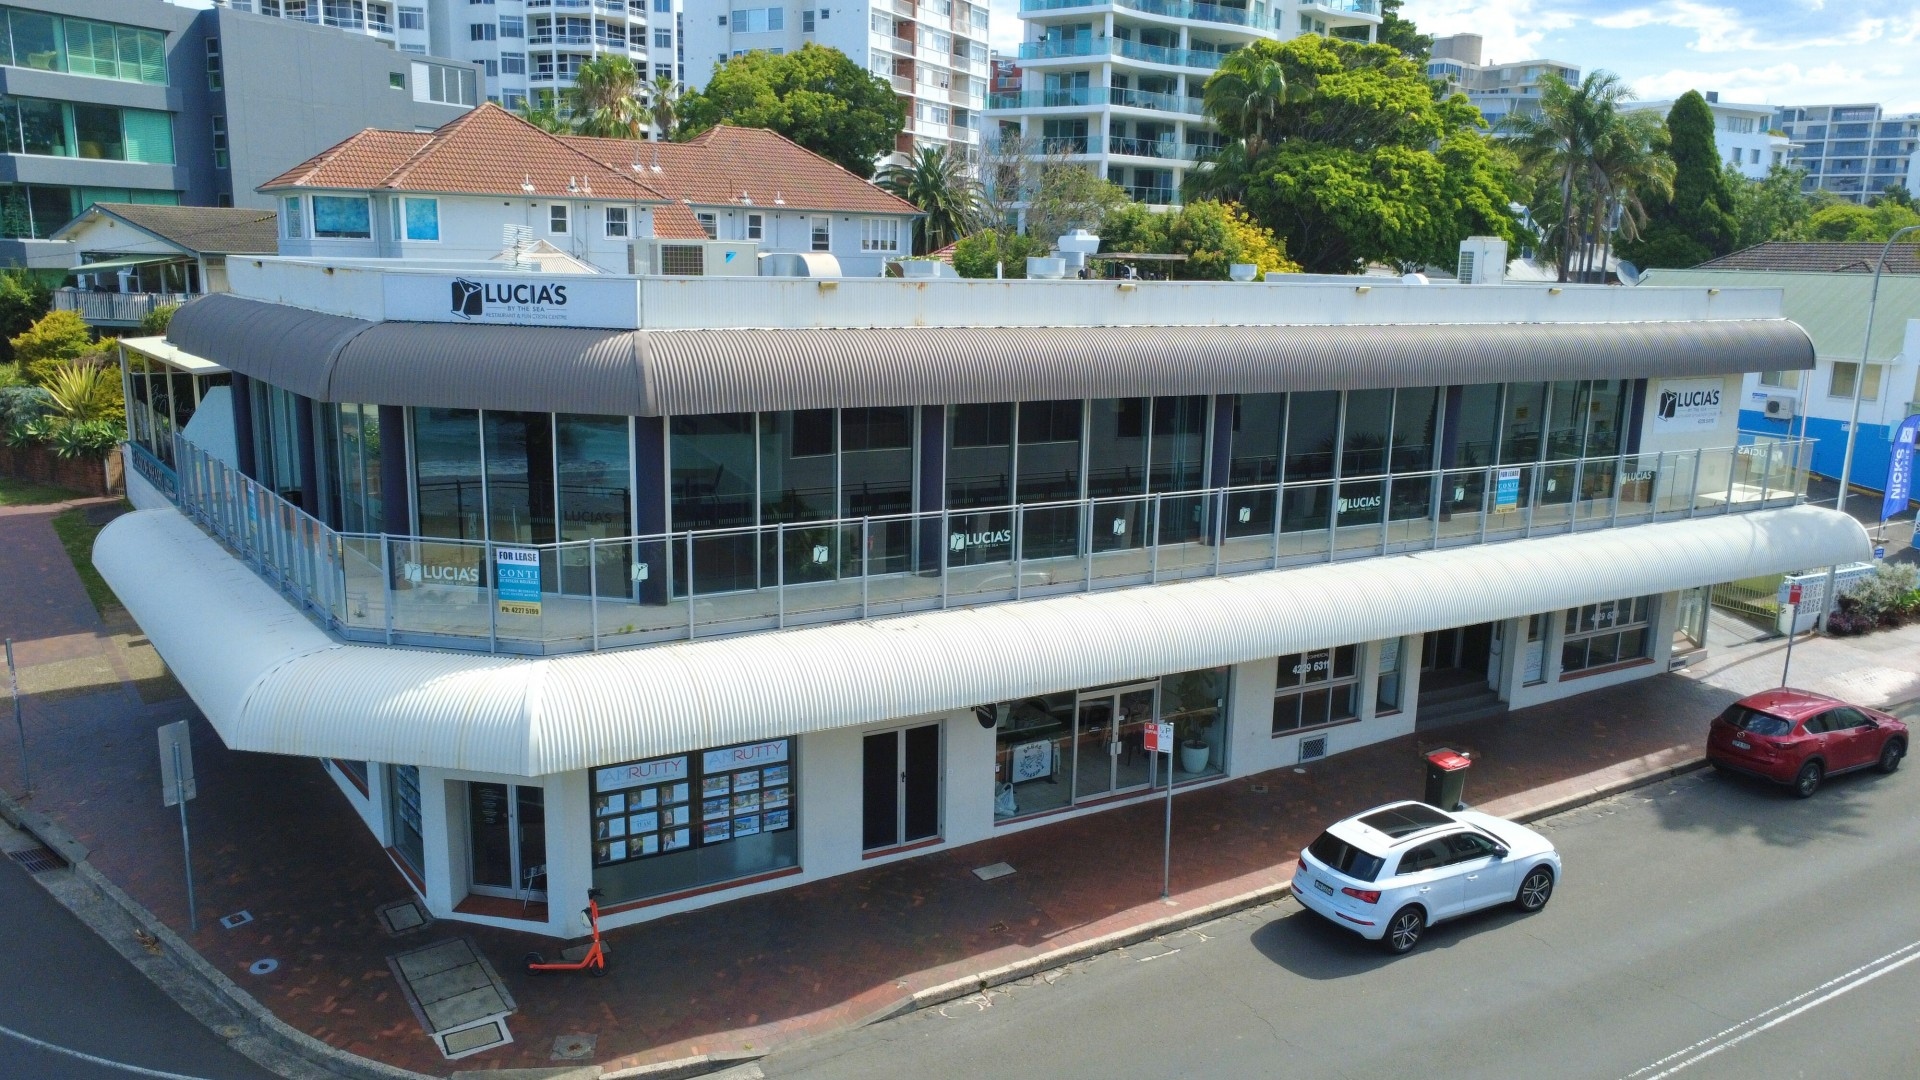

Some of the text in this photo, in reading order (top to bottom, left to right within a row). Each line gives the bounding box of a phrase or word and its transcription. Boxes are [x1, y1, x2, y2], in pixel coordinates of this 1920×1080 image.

[484, 283, 568, 306] LUCIA'S
[517, 305, 531, 313] THE
[1677, 389, 1720, 408] LUCIA'S
[1891, 449, 1905, 500] NICK'S
[966, 529, 1011, 546] LUCIA'S
[499, 551, 537, 562] FOR LEASE
[423, 565, 479, 582] LUCIA'S
[498, 568, 539, 579] CONTI
